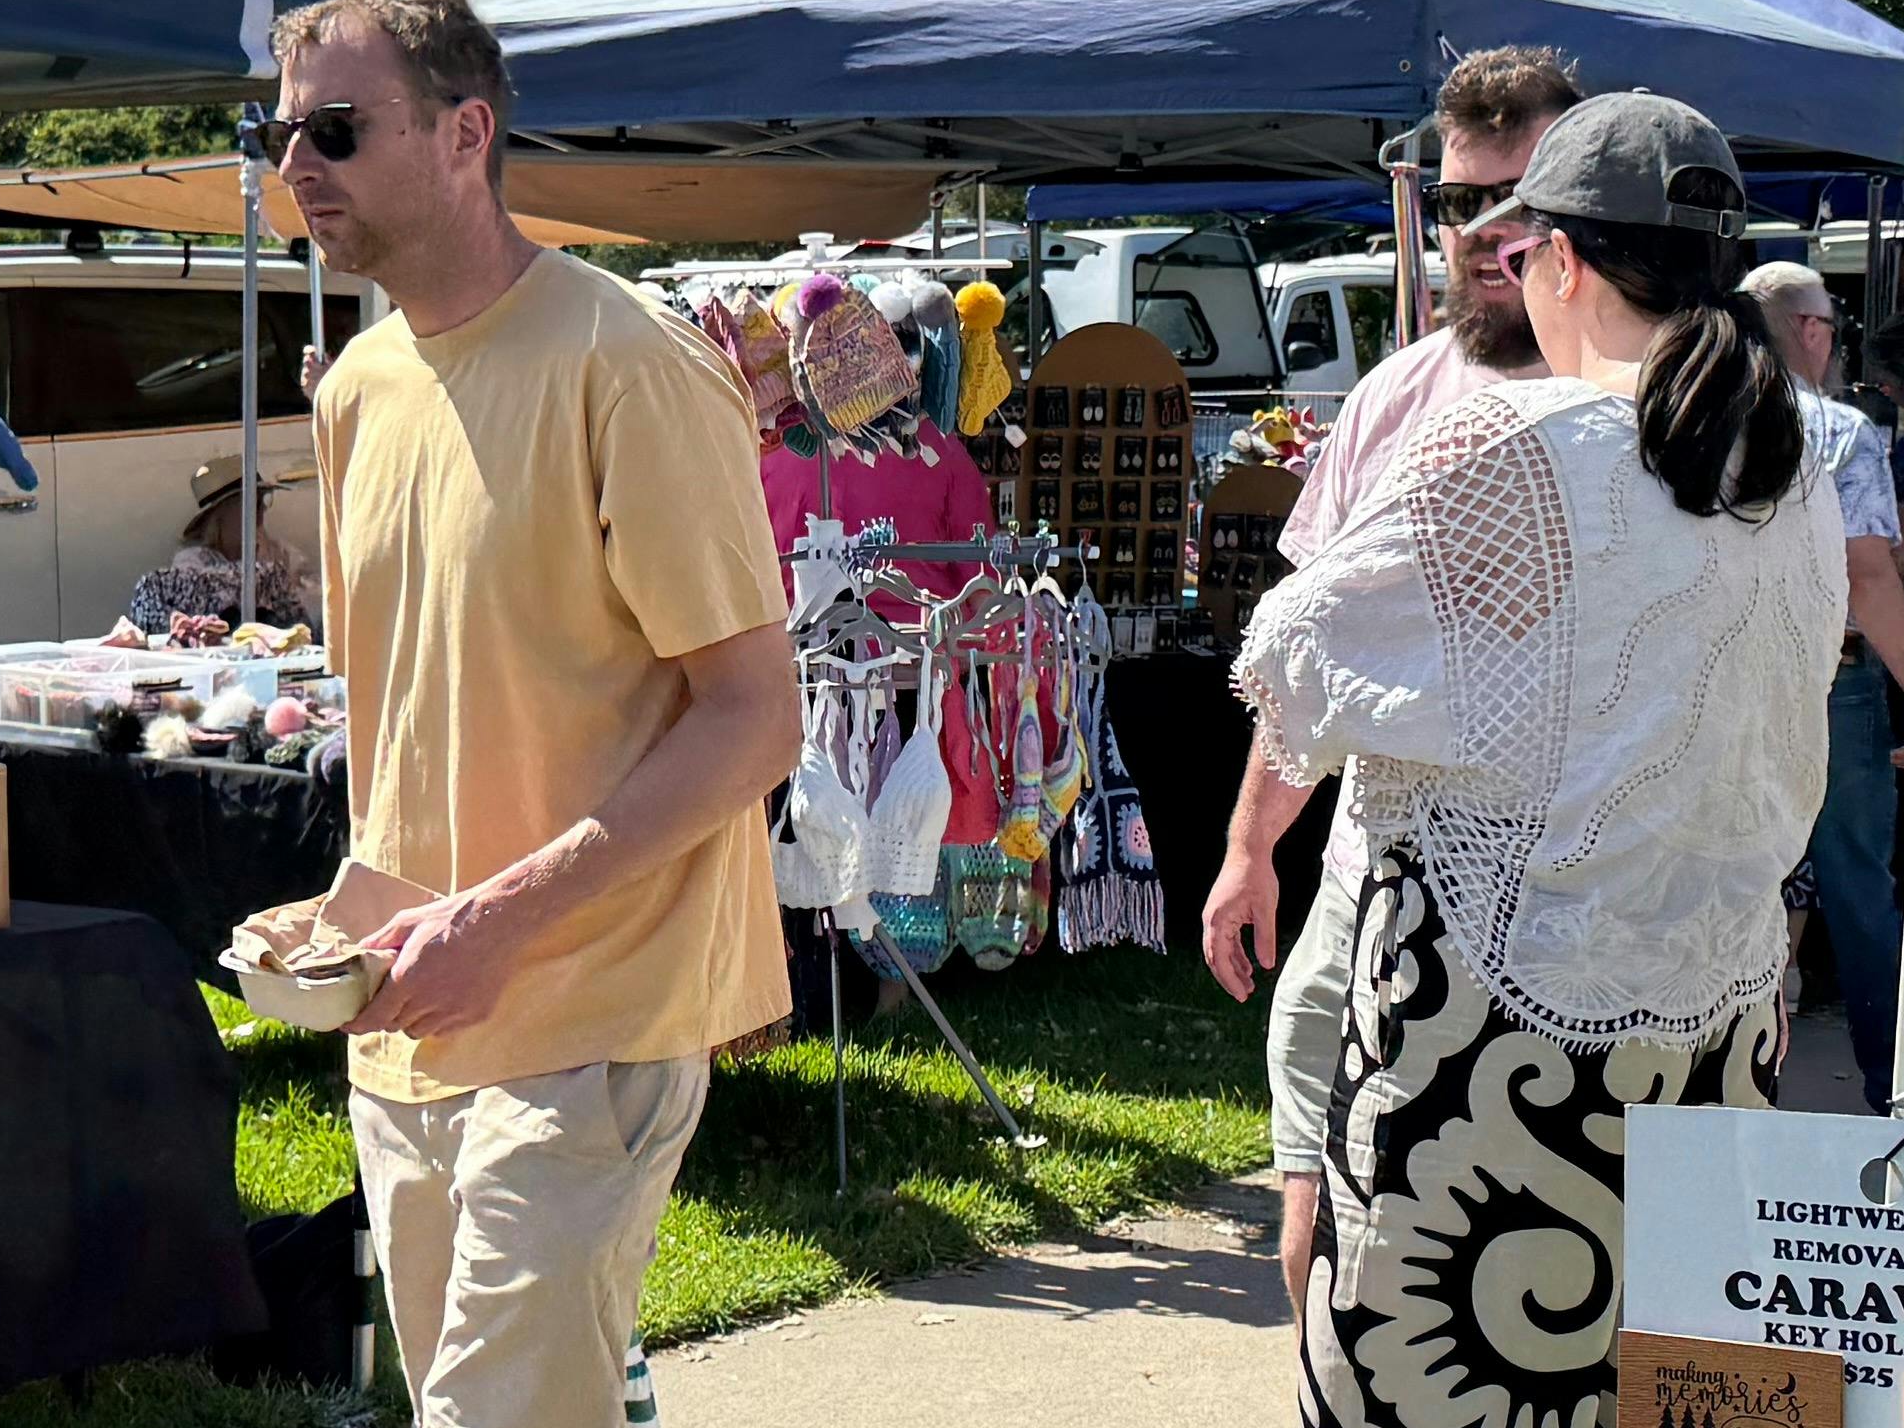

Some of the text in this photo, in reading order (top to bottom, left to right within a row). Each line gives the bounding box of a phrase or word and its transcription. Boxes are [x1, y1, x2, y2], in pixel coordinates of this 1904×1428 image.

[1764, 1321, 1827, 1350] KEY
[1656, 1360, 1728, 1384] making
[1843, 1363, 1894, 1389] $25
[1656, 1381, 1809, 1423] memories
